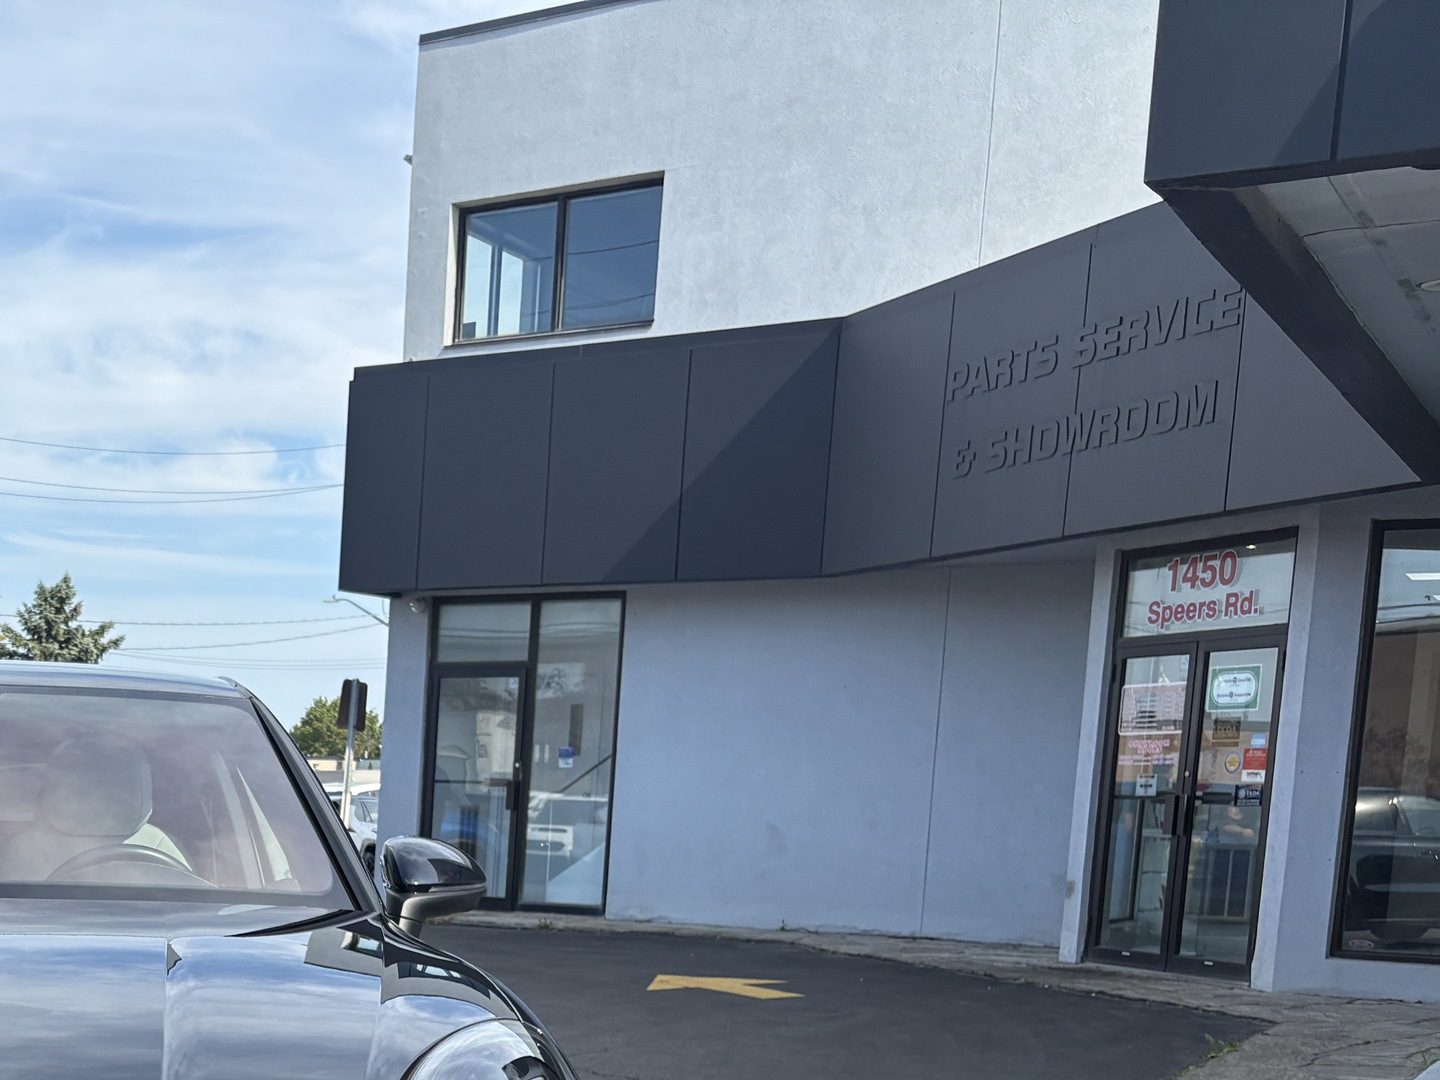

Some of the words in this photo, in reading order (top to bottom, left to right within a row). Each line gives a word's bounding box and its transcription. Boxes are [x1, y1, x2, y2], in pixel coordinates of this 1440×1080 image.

[947, 334, 1059, 404] PARTS
[1072, 285, 1242, 369] SERVICE
[953, 440, 977, 480] &
[985, 380, 1219, 474] SHOWROOM
[1167, 550, 1238, 593] 1450
[1147, 600, 1218, 630] Speers
[1223, 590, 1259, 618] Rd.
